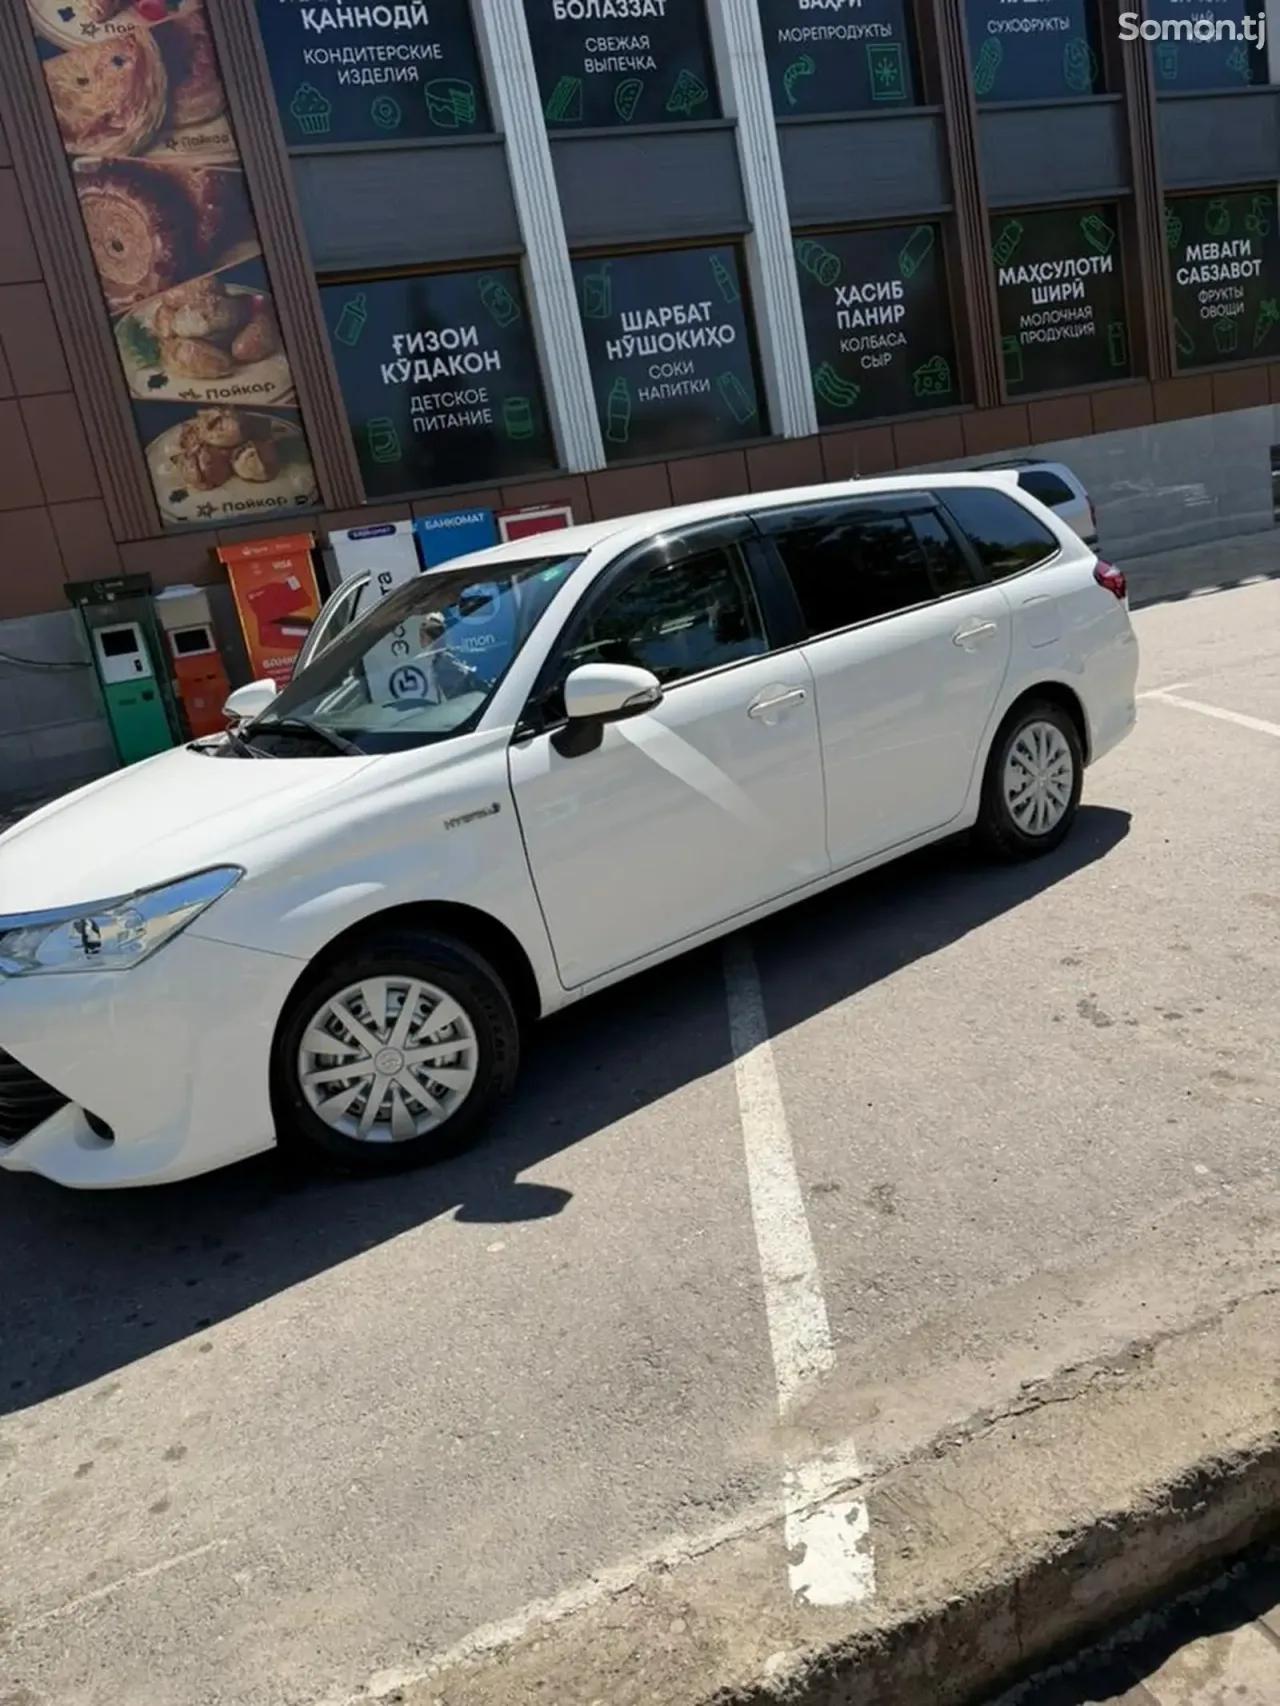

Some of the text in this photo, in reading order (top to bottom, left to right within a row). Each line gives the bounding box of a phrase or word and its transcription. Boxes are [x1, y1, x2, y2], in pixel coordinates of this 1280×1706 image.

[777, 22, 892, 43] МОРЕПРОДУКТЫ
[302, 43, 443, 65] КОНДИТЕРСКИЕ
[584, 35, 651, 53] СВЕЖАЯ
[336, 65, 420, 86] ИЗДЕЛИЯ
[583, 55, 658, 74] ВЫПЕЧКА
[1186, 238, 1252, 263] МЕВАГИ
[998, 254, 1113, 288] МАҲСУЛОТИ
[1176, 258, 1263, 286] САБЗАВОТ
[1197, 285, 1245, 305] ФРУКТЫ
[620, 300, 713, 333] ШАРБАТ
[835, 303, 907, 331] ПАНИР
[1019, 304, 1094, 330] МОЛОЧНАЯ
[1200, 301, 1245, 320] ОВОЩИ
[391, 324, 480, 356] ҒИЗОИ
[839, 331, 908, 353] КОЛБАСА
[1019, 321, 1097, 346] ПРОДУКЦИЯ
[648, 359, 695, 381] СОКИ
[859, 351, 893, 370] СЫР
[204, 380, 277, 401] Пайкар
[409, 386, 490, 415] ДЕТСКОЕ
[637, 377, 712, 403] НАПИТКИ
[412, 407, 494, 433] ПИТАНИЕ
[221, 493, 290, 514] Пайкар
